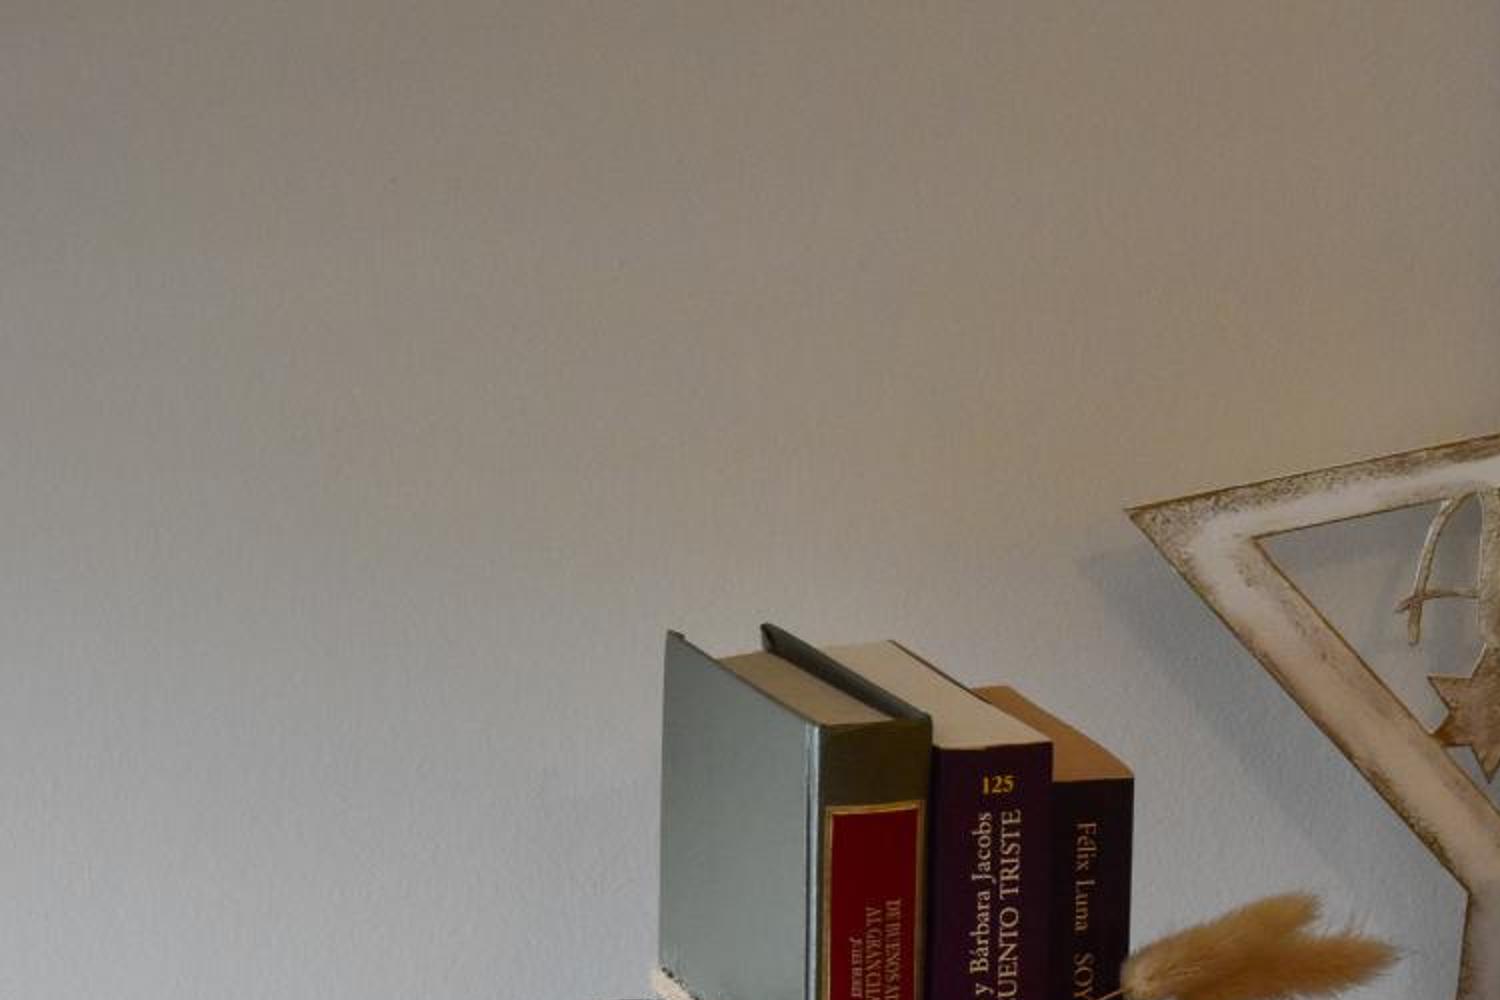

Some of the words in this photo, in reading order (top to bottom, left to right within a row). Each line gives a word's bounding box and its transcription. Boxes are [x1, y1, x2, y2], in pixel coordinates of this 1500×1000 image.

[983, 775, 1014, 795] 125
[971, 811, 996, 884] Jacobs
[998, 808, 1022, 901] TRISTE
[969, 889, 994, 975] Bárbara
[1074, 878, 1096, 932] Luna
[974, 982, 994, 996] y
